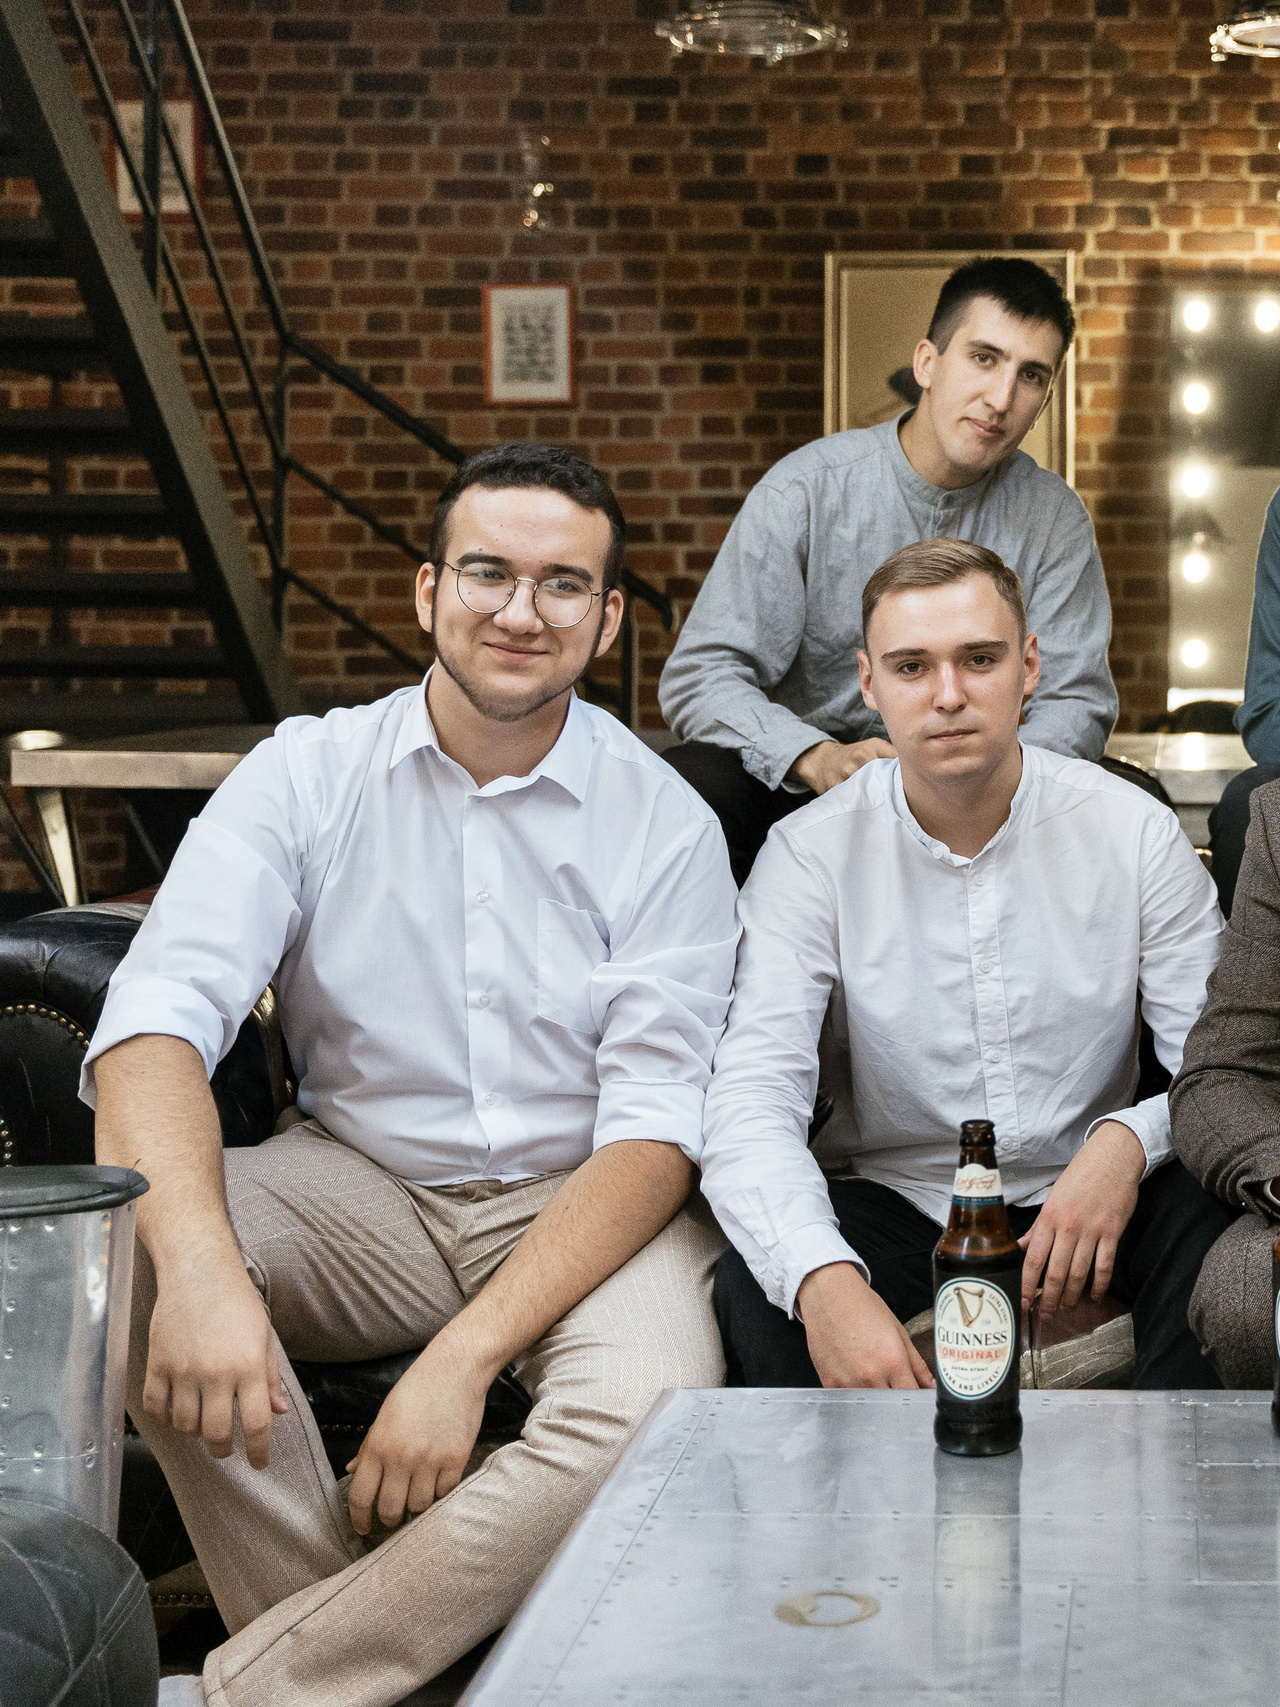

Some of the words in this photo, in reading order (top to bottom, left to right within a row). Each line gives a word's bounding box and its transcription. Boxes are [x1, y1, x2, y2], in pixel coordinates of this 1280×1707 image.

[938, 1326, 1007, 1346] GUINNESS
[942, 1347, 1001, 1359] ORIGINAL
[959, 1383, 973, 1391] AND
